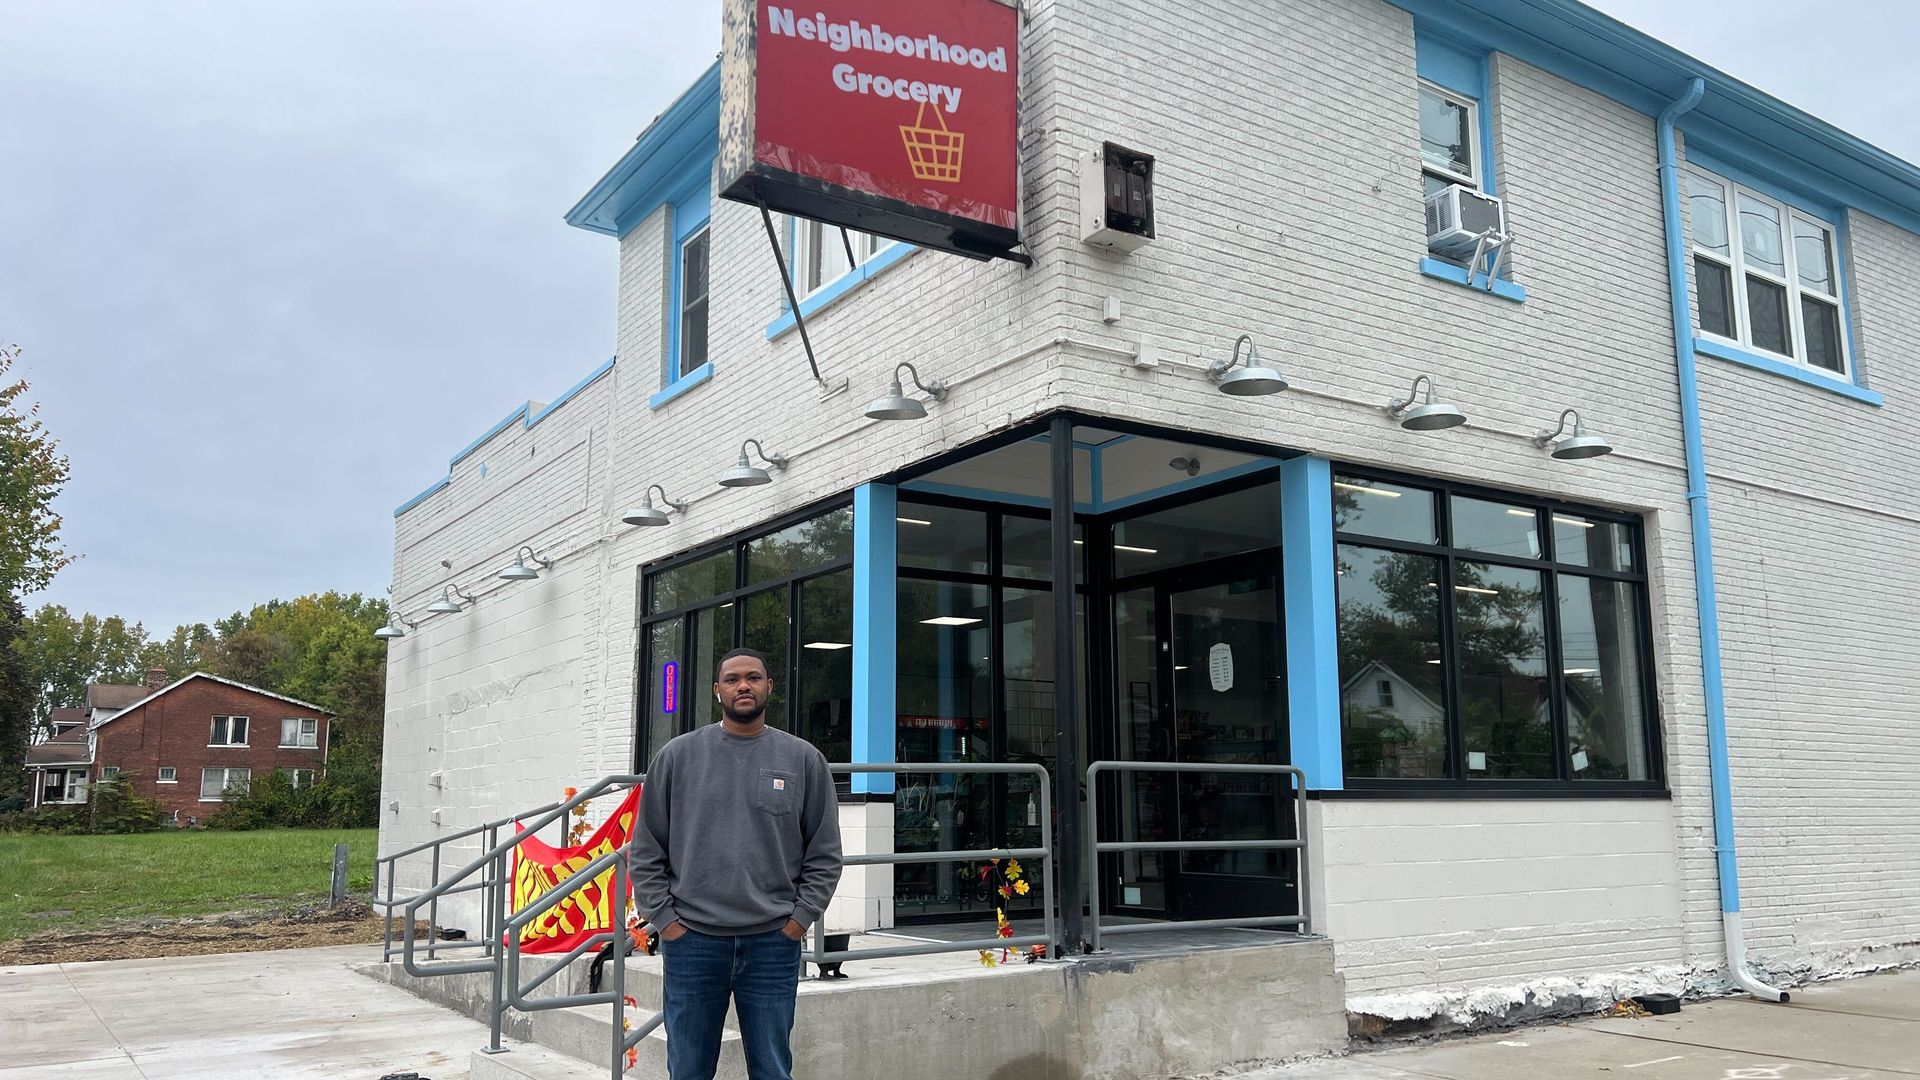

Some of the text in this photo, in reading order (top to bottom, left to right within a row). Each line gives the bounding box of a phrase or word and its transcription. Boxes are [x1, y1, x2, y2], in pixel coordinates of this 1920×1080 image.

[767, 5, 1008, 73] Neighborhood
[831, 63, 962, 113] Grocery
[666, 664, 675, 711] OPEN
